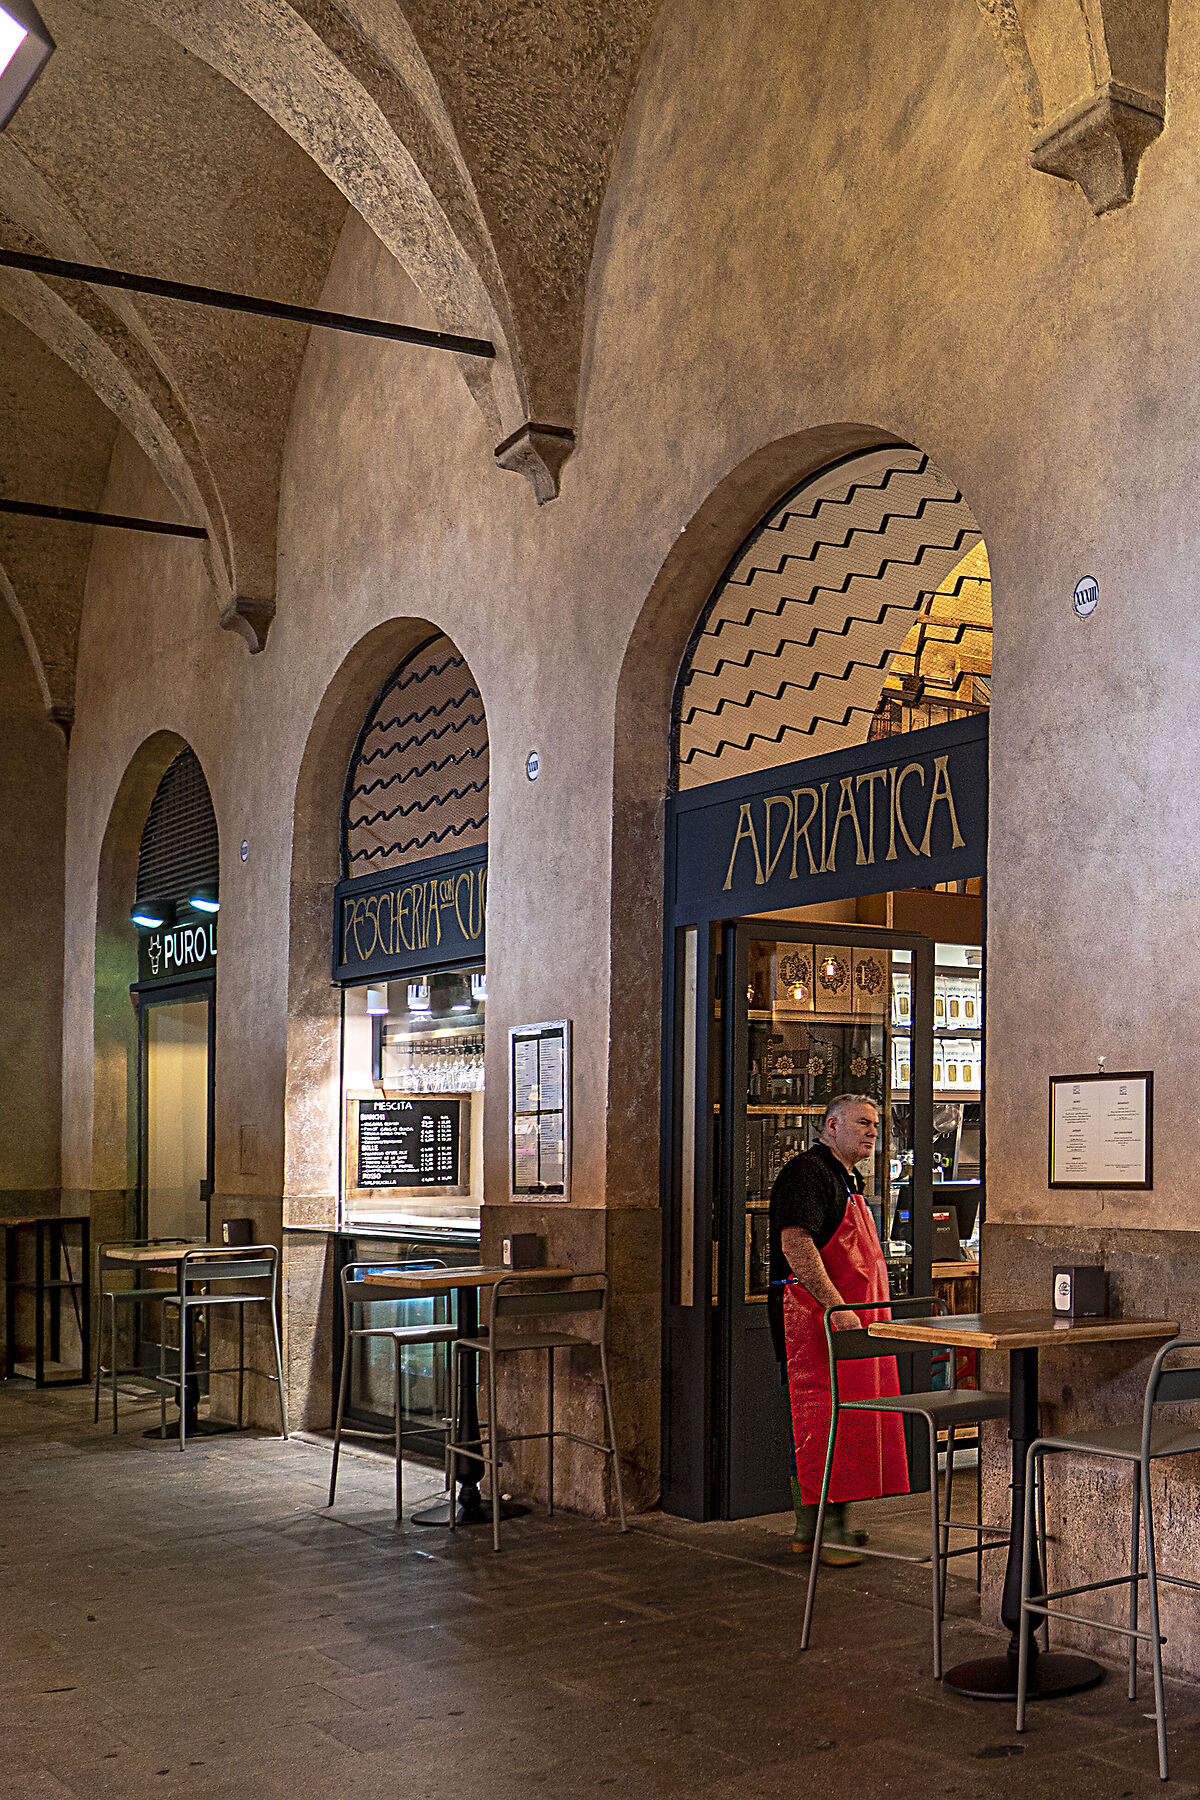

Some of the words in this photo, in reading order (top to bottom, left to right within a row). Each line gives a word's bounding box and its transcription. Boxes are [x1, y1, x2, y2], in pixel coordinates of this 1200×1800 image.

[722, 755, 966, 891] ADRIATICA
[164, 926, 207, 968] PURO
[343, 879, 441, 964] PESCHERIA
[440, 876, 456, 903] CON
[455, 867, 488, 940] CU
[373, 1101, 413, 1111] MESCITA
